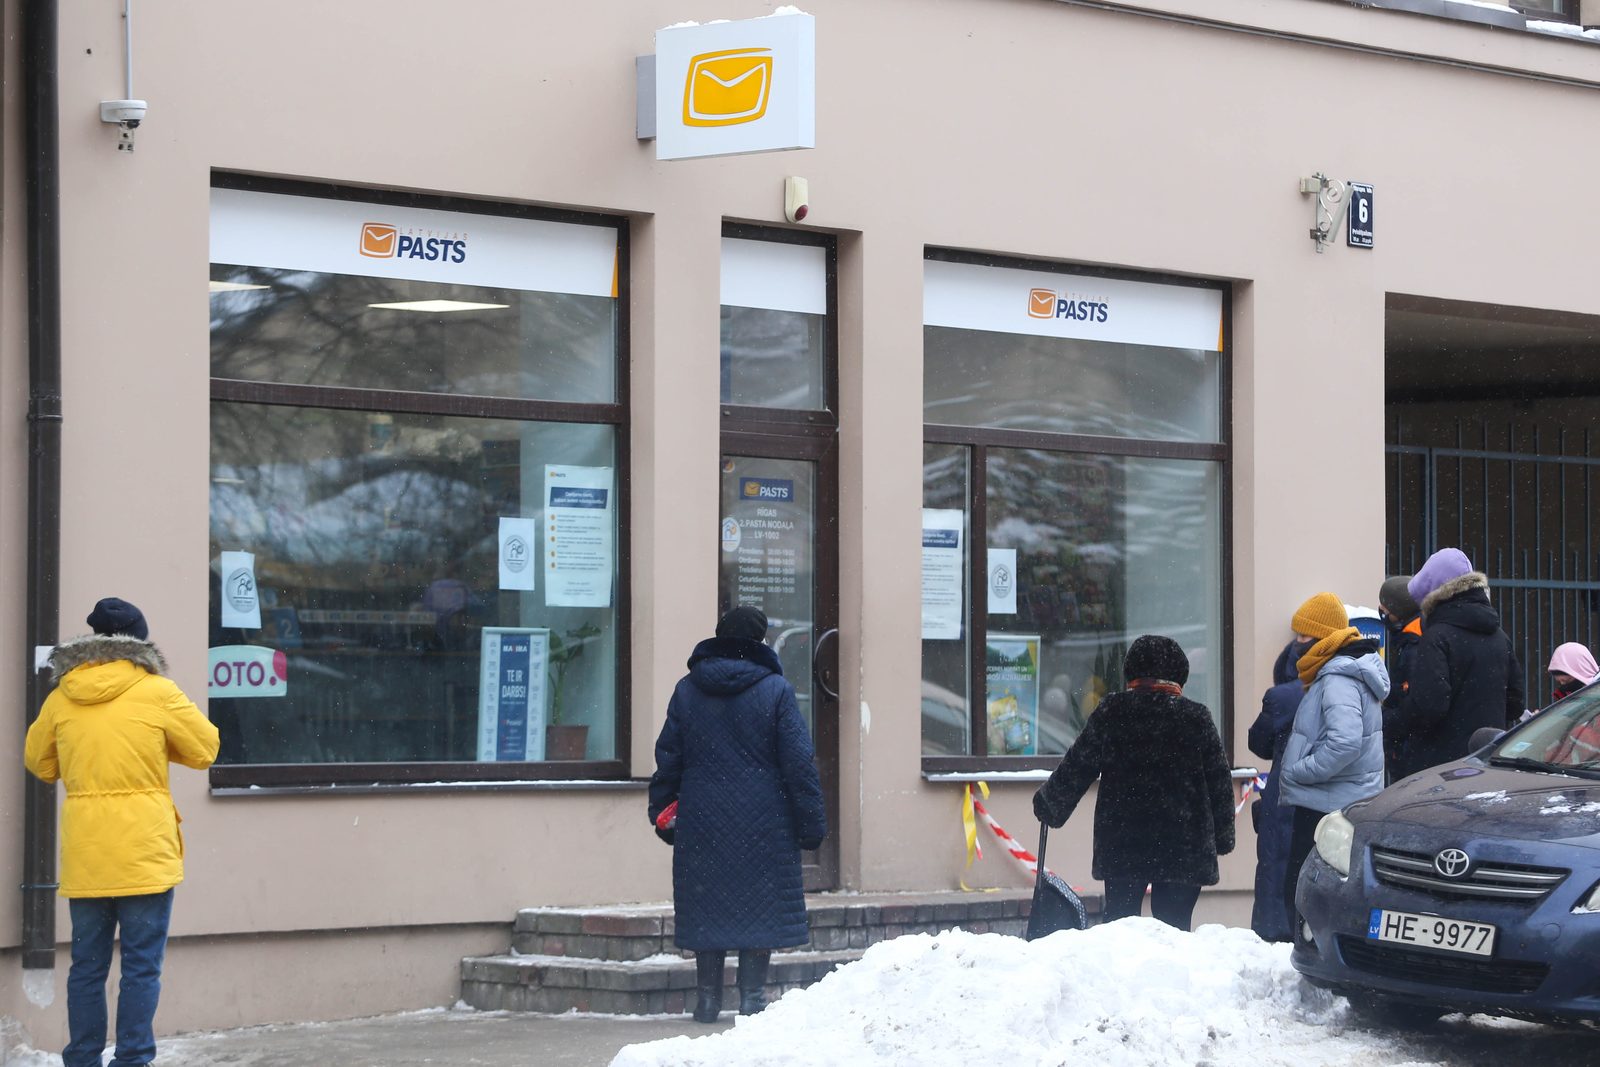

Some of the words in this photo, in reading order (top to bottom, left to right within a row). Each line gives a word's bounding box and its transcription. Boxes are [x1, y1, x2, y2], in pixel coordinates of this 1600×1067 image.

[1359, 198, 1368, 224] 6
[399, 226, 468, 241] LATVIJAS
[397, 235, 466, 263] PASTS
[1056, 299, 1108, 322] PASTS
[760, 487, 789, 498] PASTS
[757, 506, 777, 517] RĪGAS
[507, 670, 515, 682] TE
[515, 670, 523, 682] IR
[502, 685, 526, 698] DARBS!
[1370, 926, 1379, 934] LV
[1385, 914, 1491, 950] HE-9977
